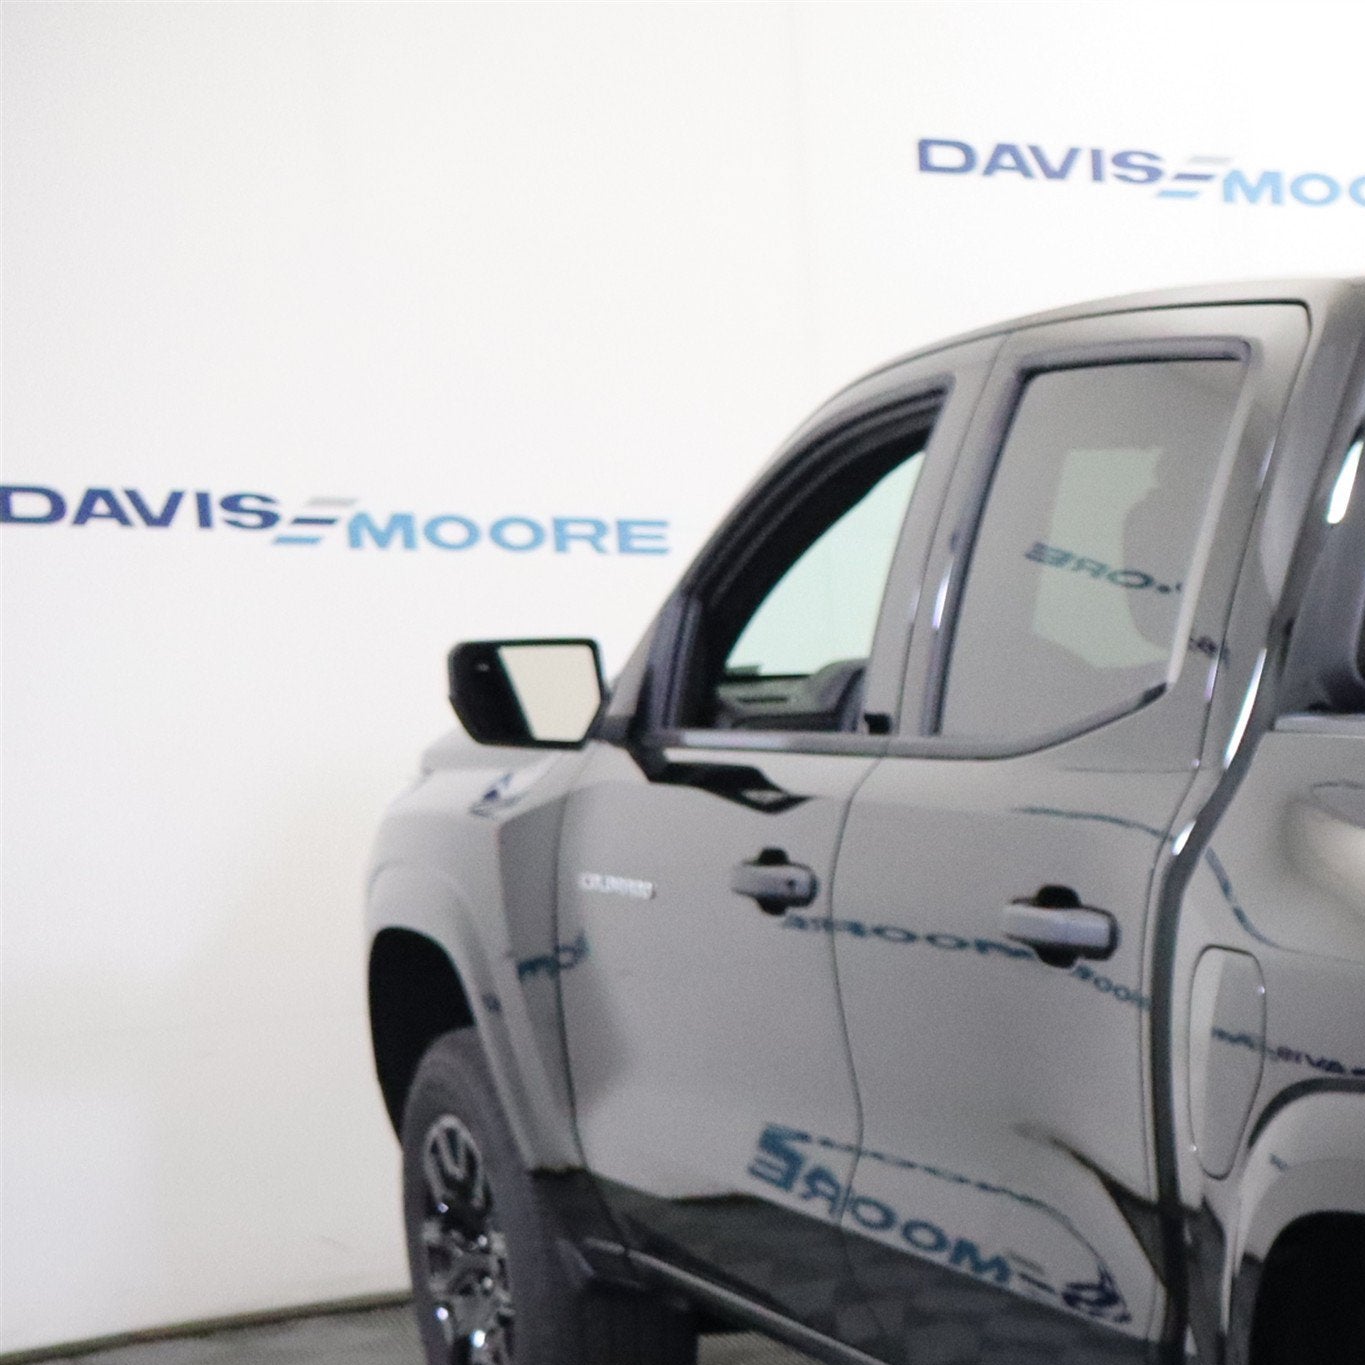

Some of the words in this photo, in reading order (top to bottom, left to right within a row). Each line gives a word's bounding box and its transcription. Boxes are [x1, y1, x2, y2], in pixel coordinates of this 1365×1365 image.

[917, 137, 1164, 183] DAVIS
[0, 485, 280, 528] DAVIS
[347, 512, 670, 555] MOORE
